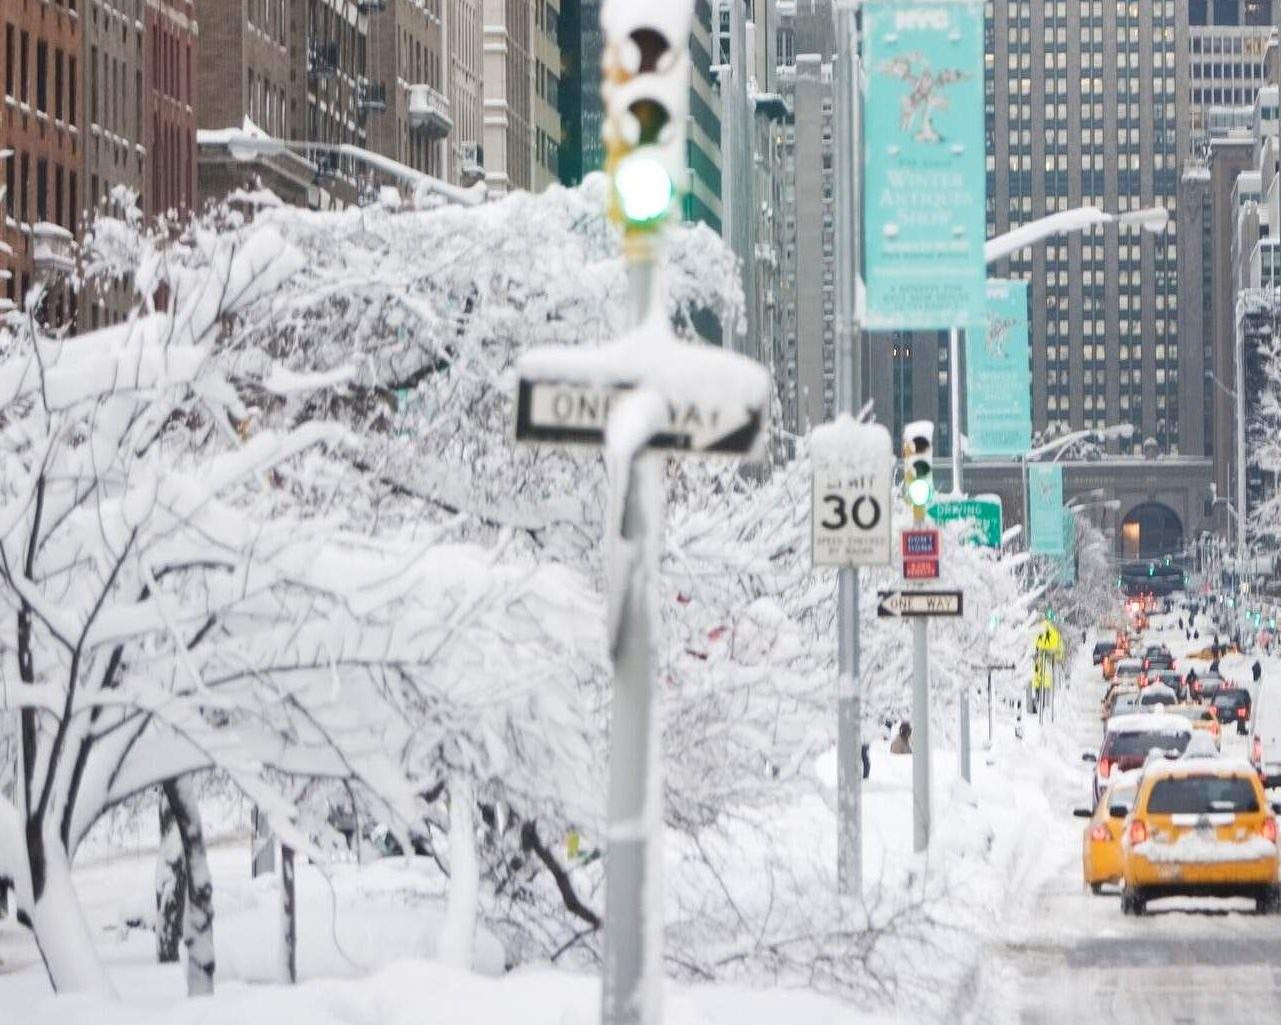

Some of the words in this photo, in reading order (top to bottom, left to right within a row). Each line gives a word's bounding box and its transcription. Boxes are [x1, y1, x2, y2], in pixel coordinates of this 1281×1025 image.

[822, 494, 881, 531] 30
[890, 597, 912, 609] ONE
[926, 597, 953, 609] WAY
